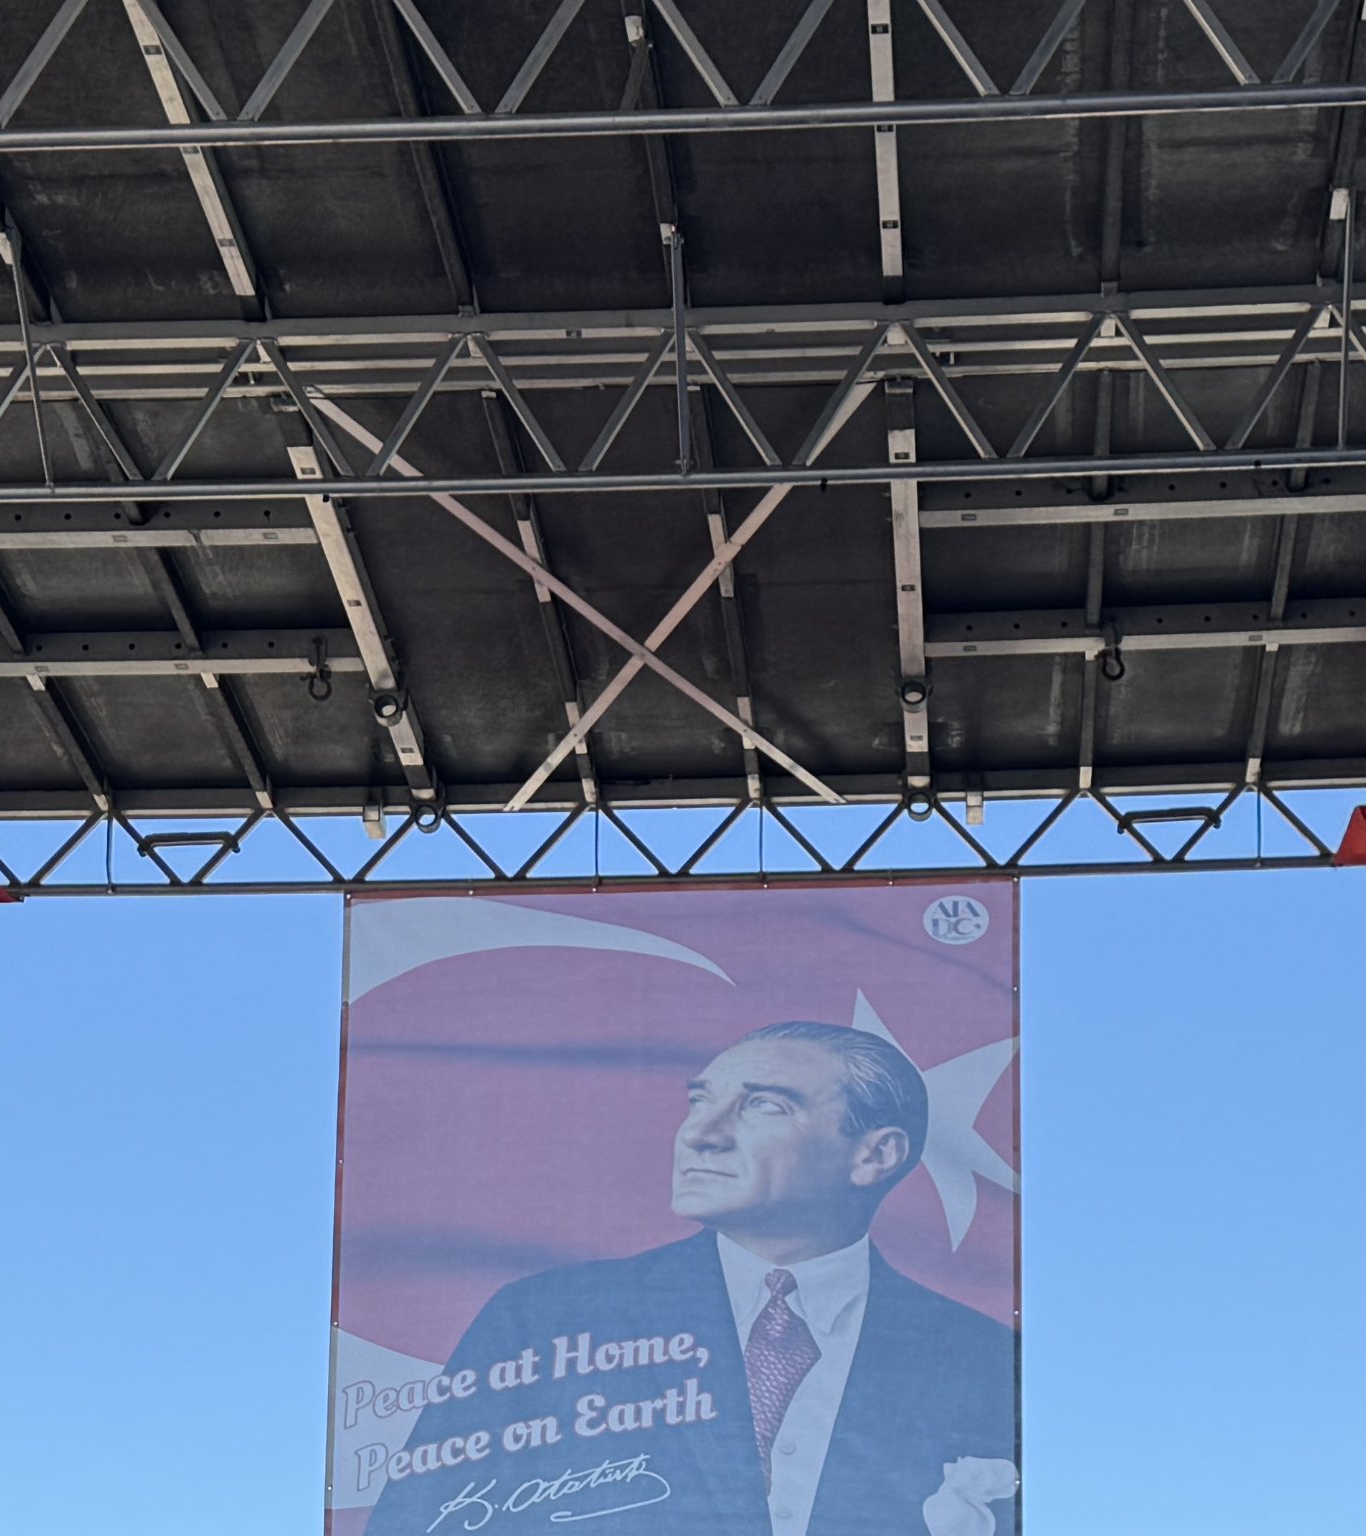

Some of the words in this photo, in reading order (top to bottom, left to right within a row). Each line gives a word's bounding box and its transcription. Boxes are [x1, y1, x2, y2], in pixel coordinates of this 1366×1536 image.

[342, 1367, 477, 1430] Peace
[488, 1348, 540, 1391] at
[552, 1330, 711, 1381] Home,
[355, 1428, 491, 1492] Peace
[502, 1414, 563, 1453] on
[573, 1376, 718, 1438] Earth
